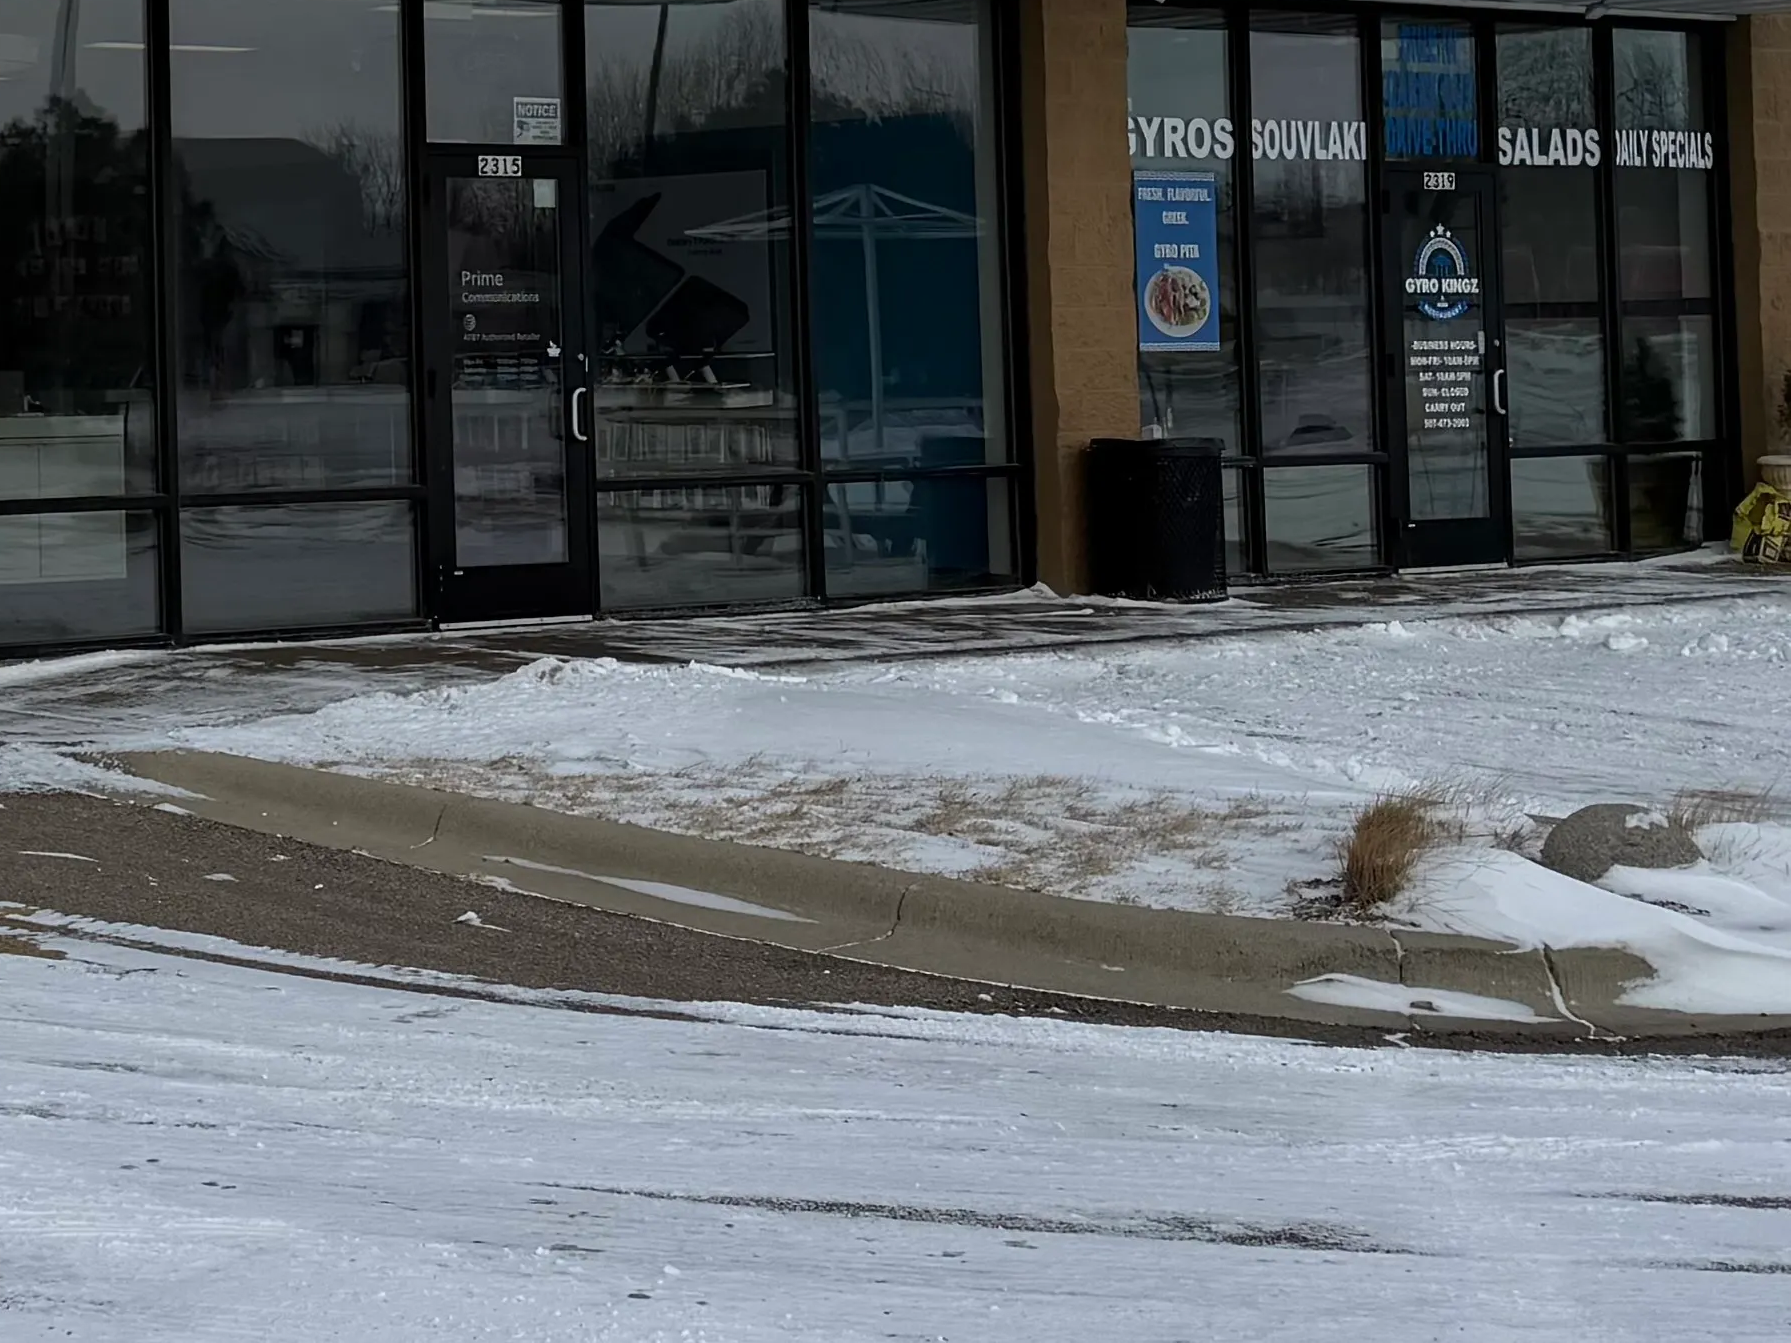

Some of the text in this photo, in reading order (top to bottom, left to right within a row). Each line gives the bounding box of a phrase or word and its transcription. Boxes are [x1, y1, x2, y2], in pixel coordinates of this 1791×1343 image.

[516, 103, 557, 117] NOTICE
[1251, 119, 1367, 160] SOUVLAKI
[1497, 126, 1602, 167] SALADS
[1652, 130, 1714, 170] SPECIALS
[479, 157, 521, 175] 2315
[1424, 173, 1455, 189] 2319
[461, 270, 504, 286] Prime
[1405, 278, 1480, 294] GYRO KINGZ
